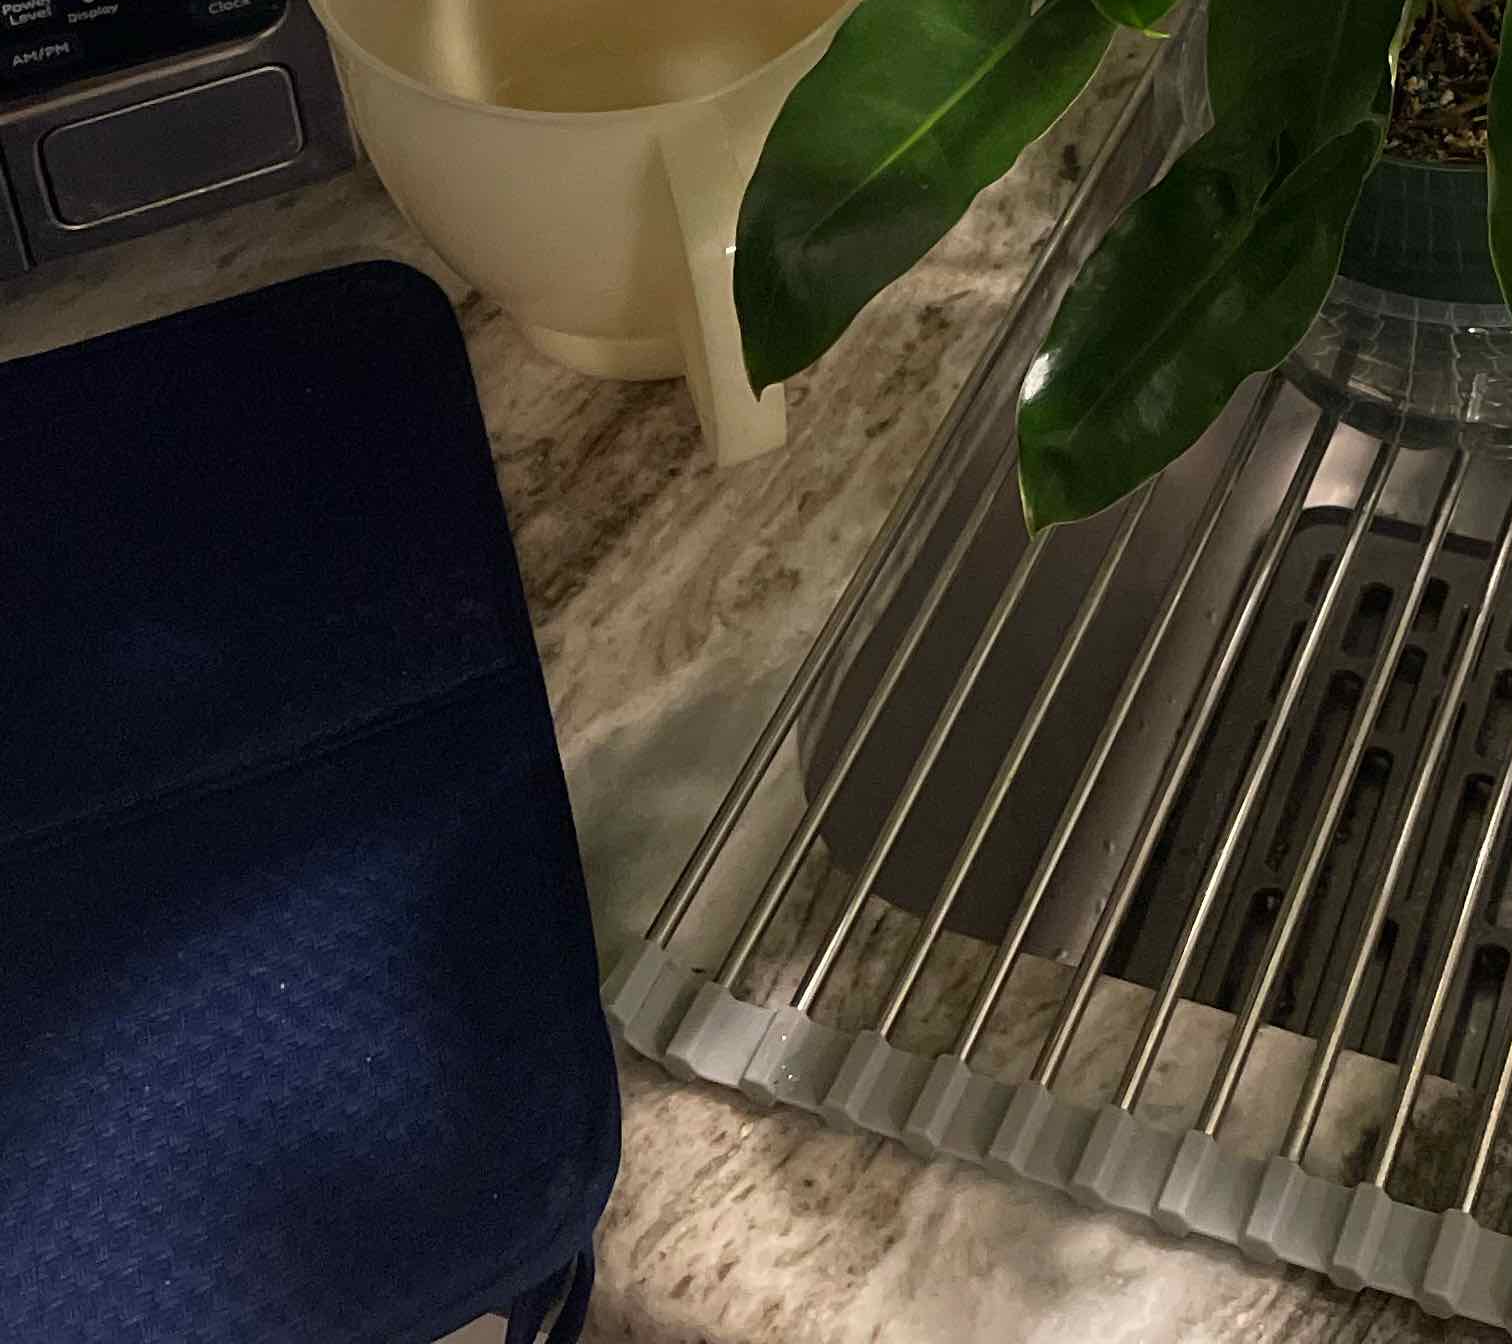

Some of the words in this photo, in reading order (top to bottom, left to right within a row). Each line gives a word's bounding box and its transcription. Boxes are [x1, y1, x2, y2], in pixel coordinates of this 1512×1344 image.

[10, 8, 53, 26] Level
[67, 3, 119, 23] Display
[13, 41, 70, 66] AM/PM
